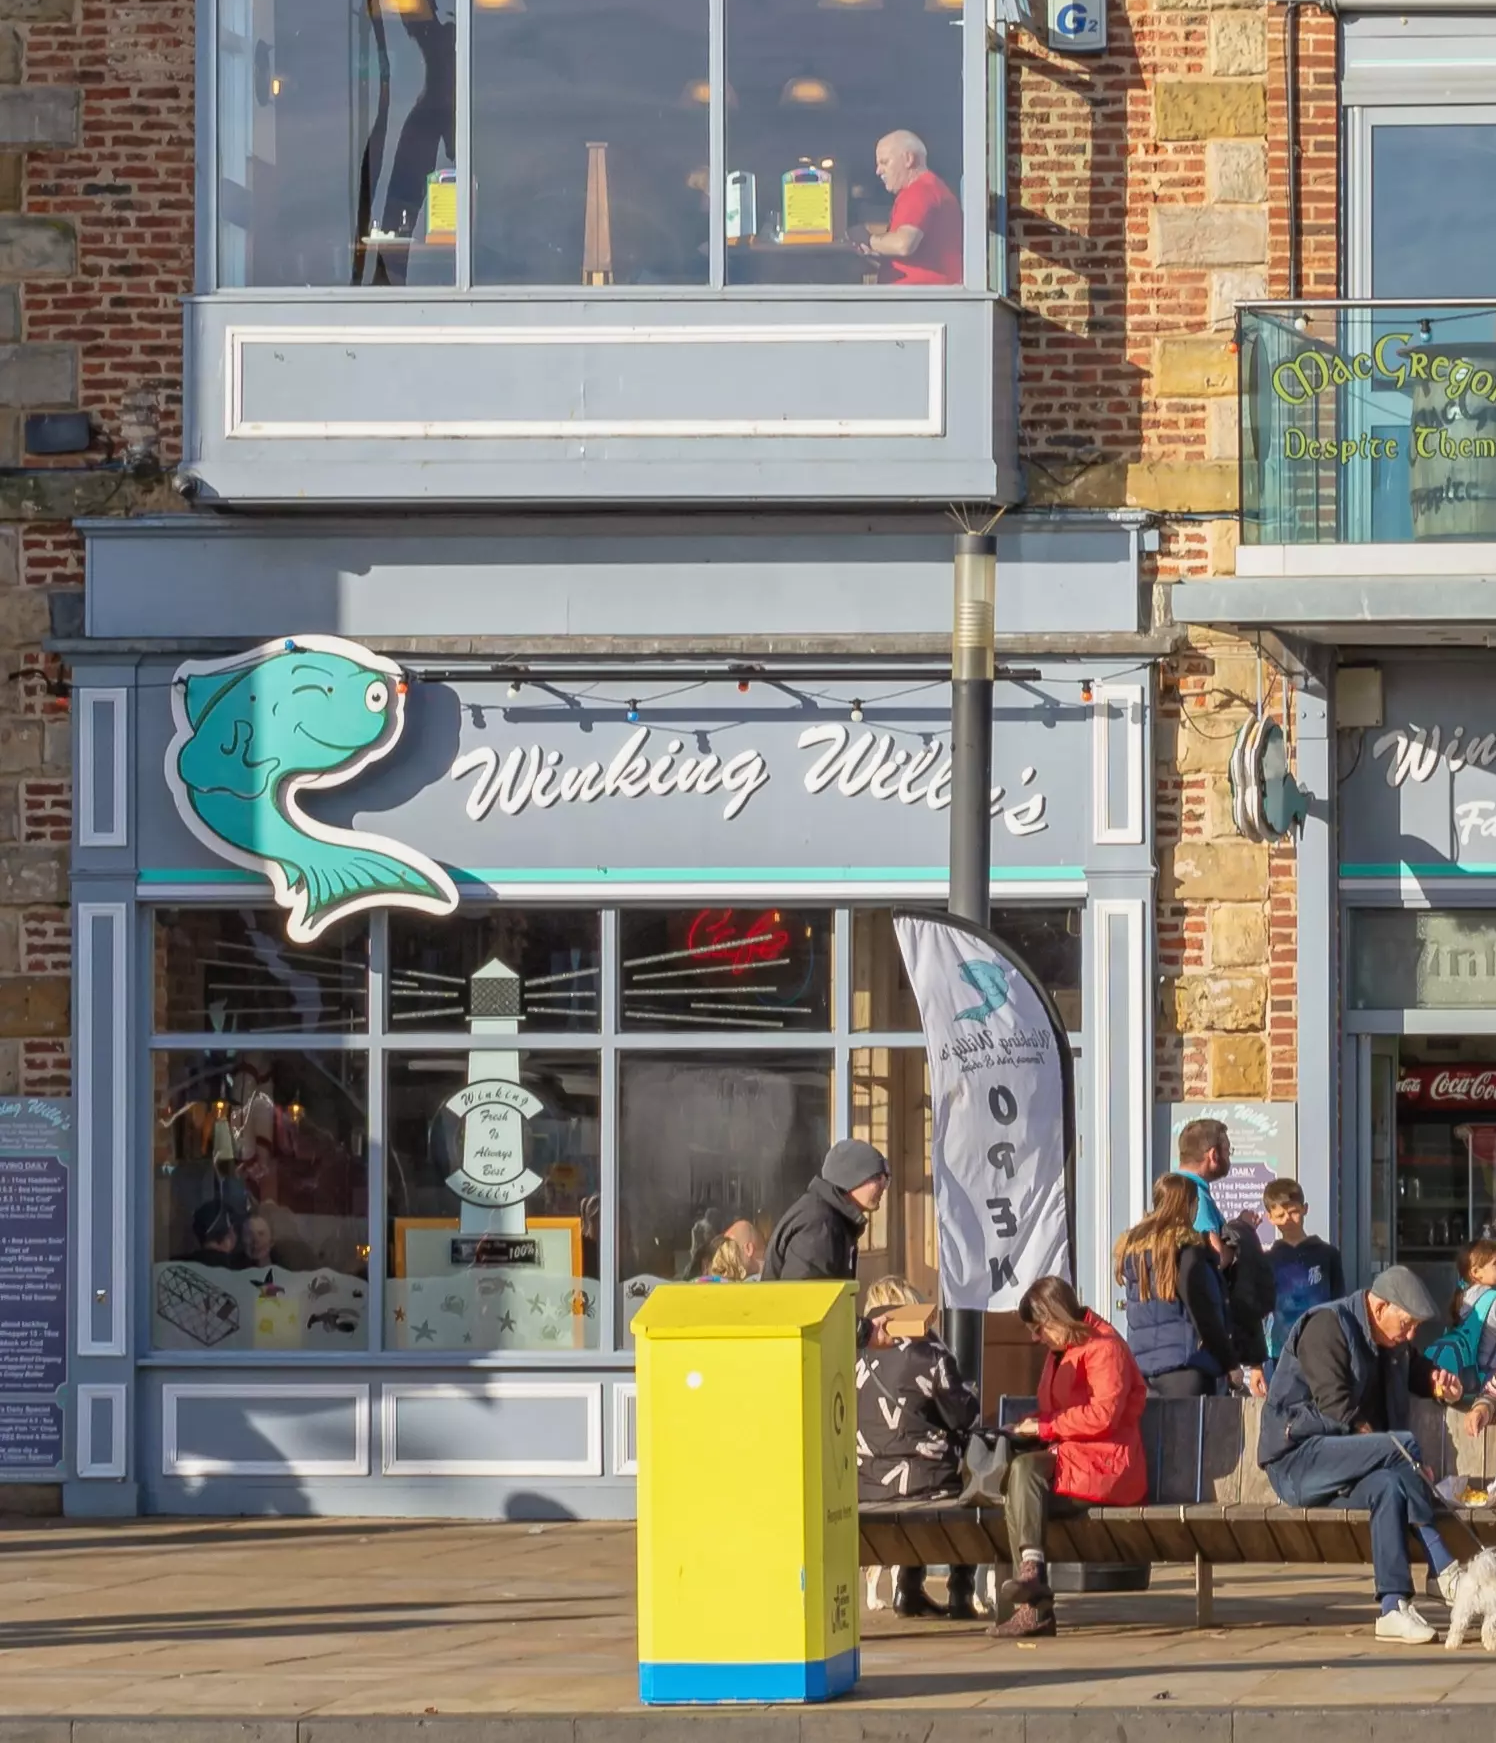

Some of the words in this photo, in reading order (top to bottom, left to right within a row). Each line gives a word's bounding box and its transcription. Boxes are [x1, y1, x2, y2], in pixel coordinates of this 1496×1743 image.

[1283, 426, 1401, 464] Despite
[1413, 424, 1496, 461] Them
[451, 725, 769, 821] Winking
[797, 722, 1050, 837] Will's
[461, 1089, 529, 1107] Winking
[480, 1109, 509, 1125] Fresh
[473, 1145, 513, 1159] Always
[482, 1163, 506, 1177] Best
[1231, 1167, 1256, 1177] DAILY
[461, 1181, 526, 1202] Willy's
